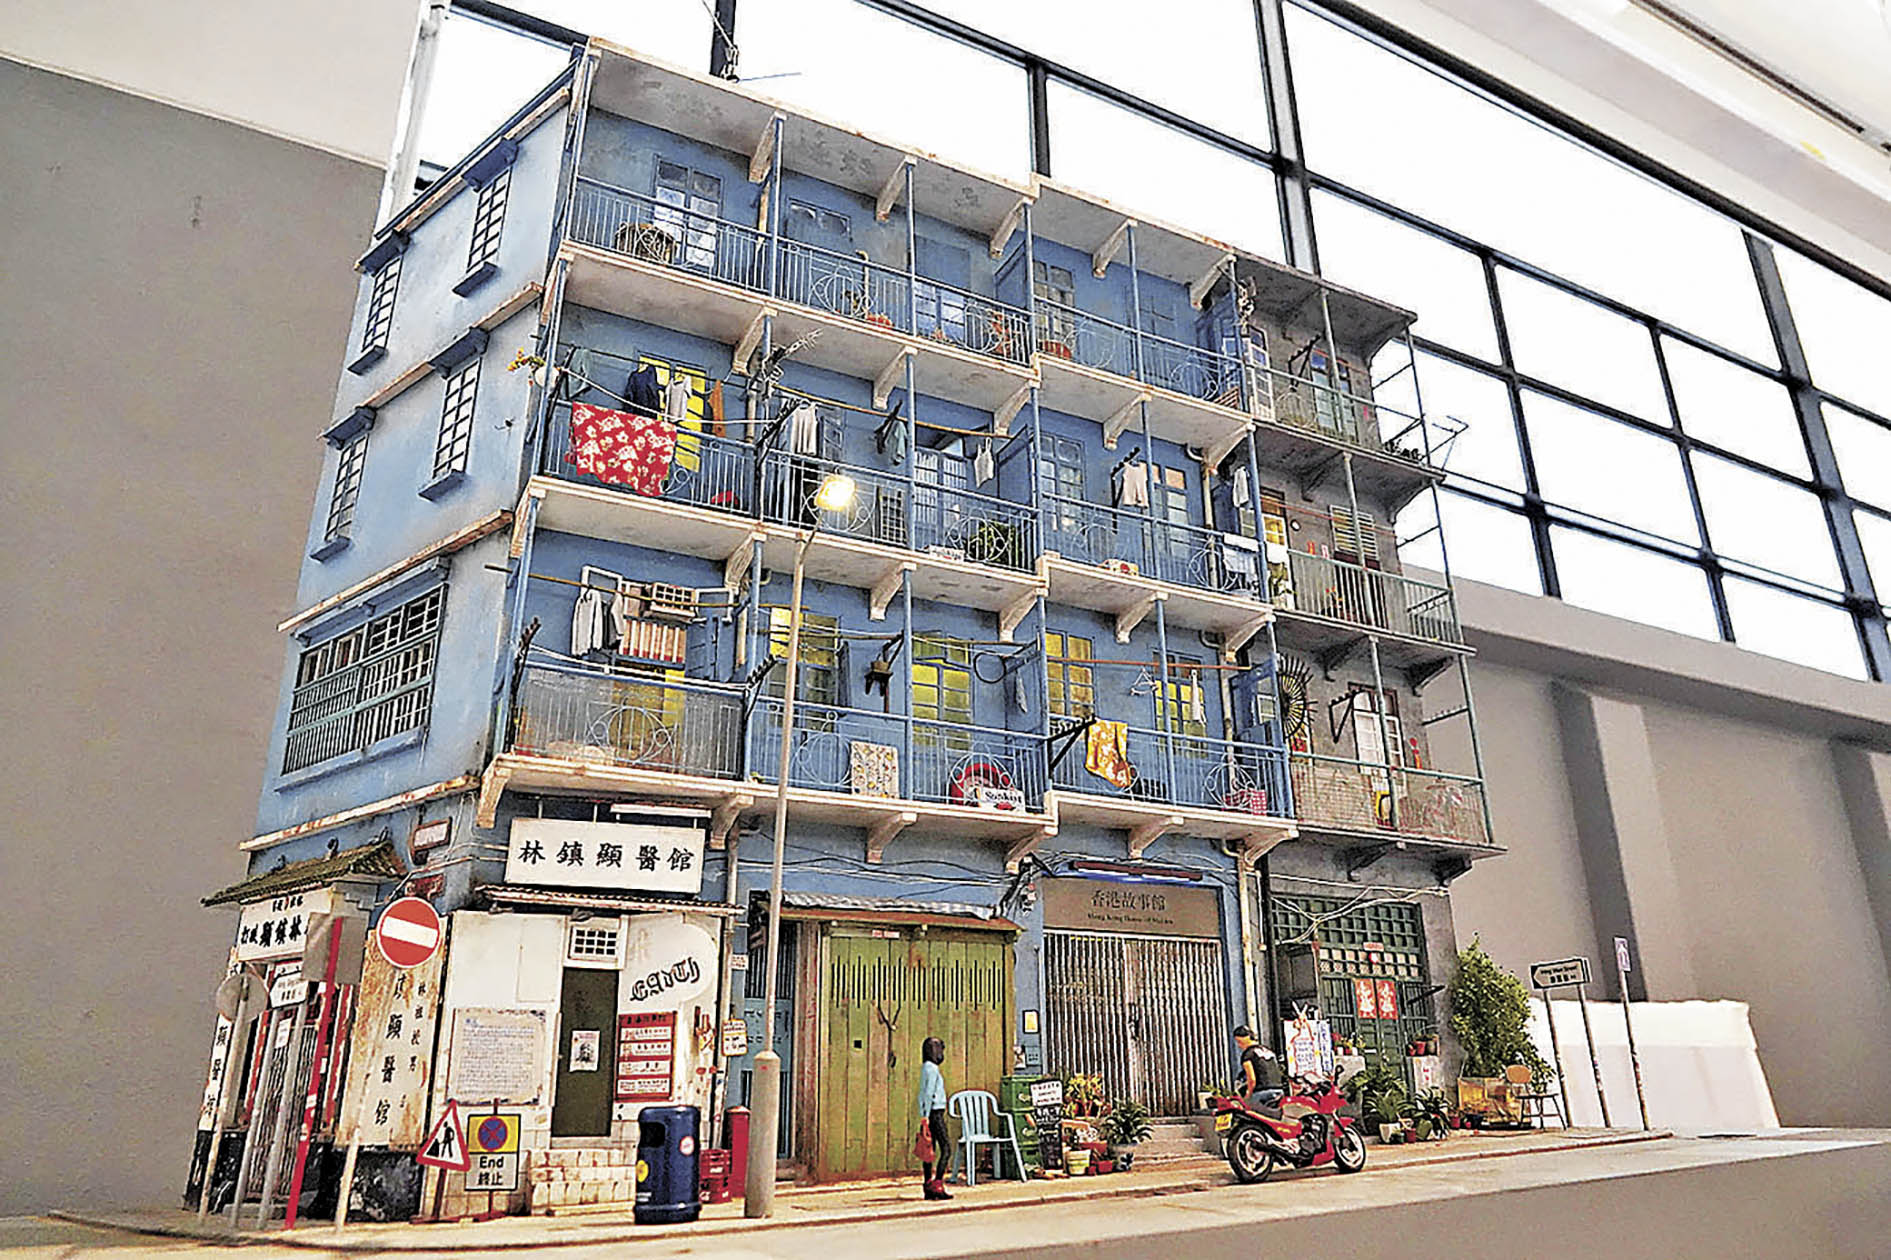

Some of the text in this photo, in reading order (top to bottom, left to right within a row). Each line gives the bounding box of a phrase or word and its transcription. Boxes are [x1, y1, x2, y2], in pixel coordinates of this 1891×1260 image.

[518, 839, 695, 873] 林鎮顯醫館
[479, 1156, 504, 1169] End
[476, 1172, 504, 1186] 終止
